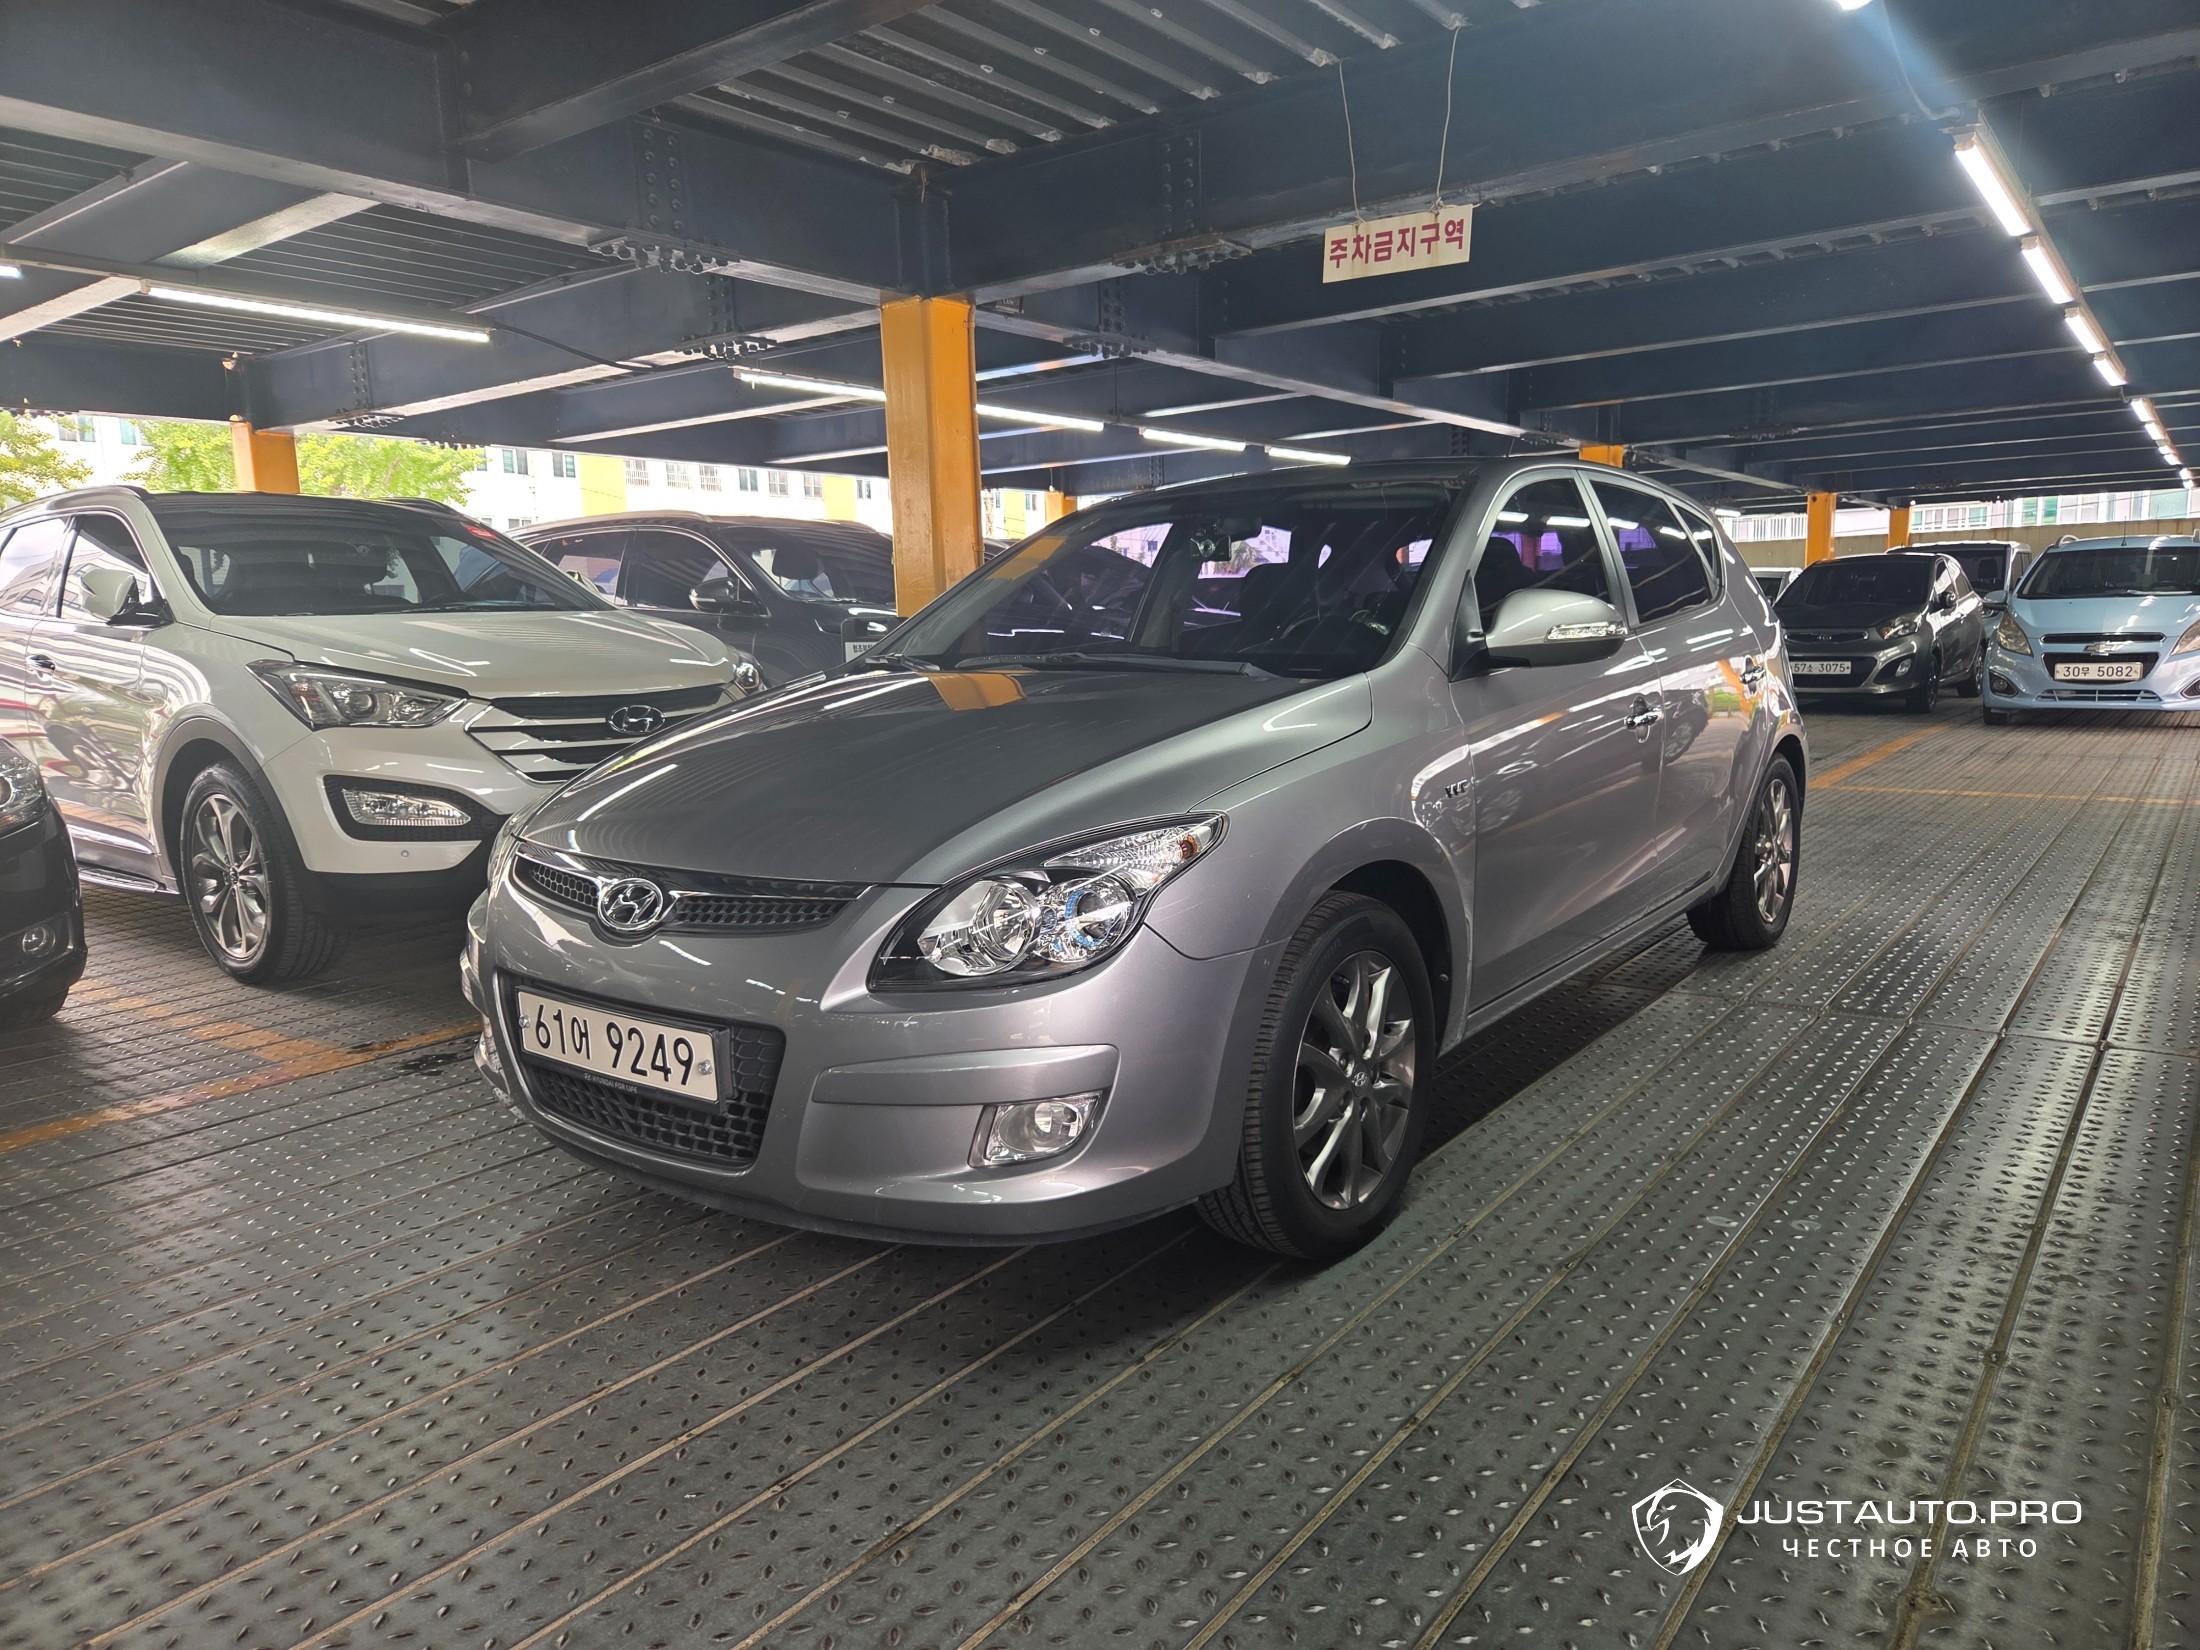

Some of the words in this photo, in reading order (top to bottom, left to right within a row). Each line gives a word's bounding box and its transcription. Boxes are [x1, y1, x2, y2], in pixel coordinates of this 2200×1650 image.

[1329, 219, 1464, 268] 주차금지구역
[1794, 663, 1813, 672] 57소
[1818, 663, 1846, 673] 3075
[2062, 666, 2090, 677] 30무
[2097, 666, 2133, 677] 5082
[535, 1004, 591, 1060] 61어
[606, 1021, 695, 1085] 9249
